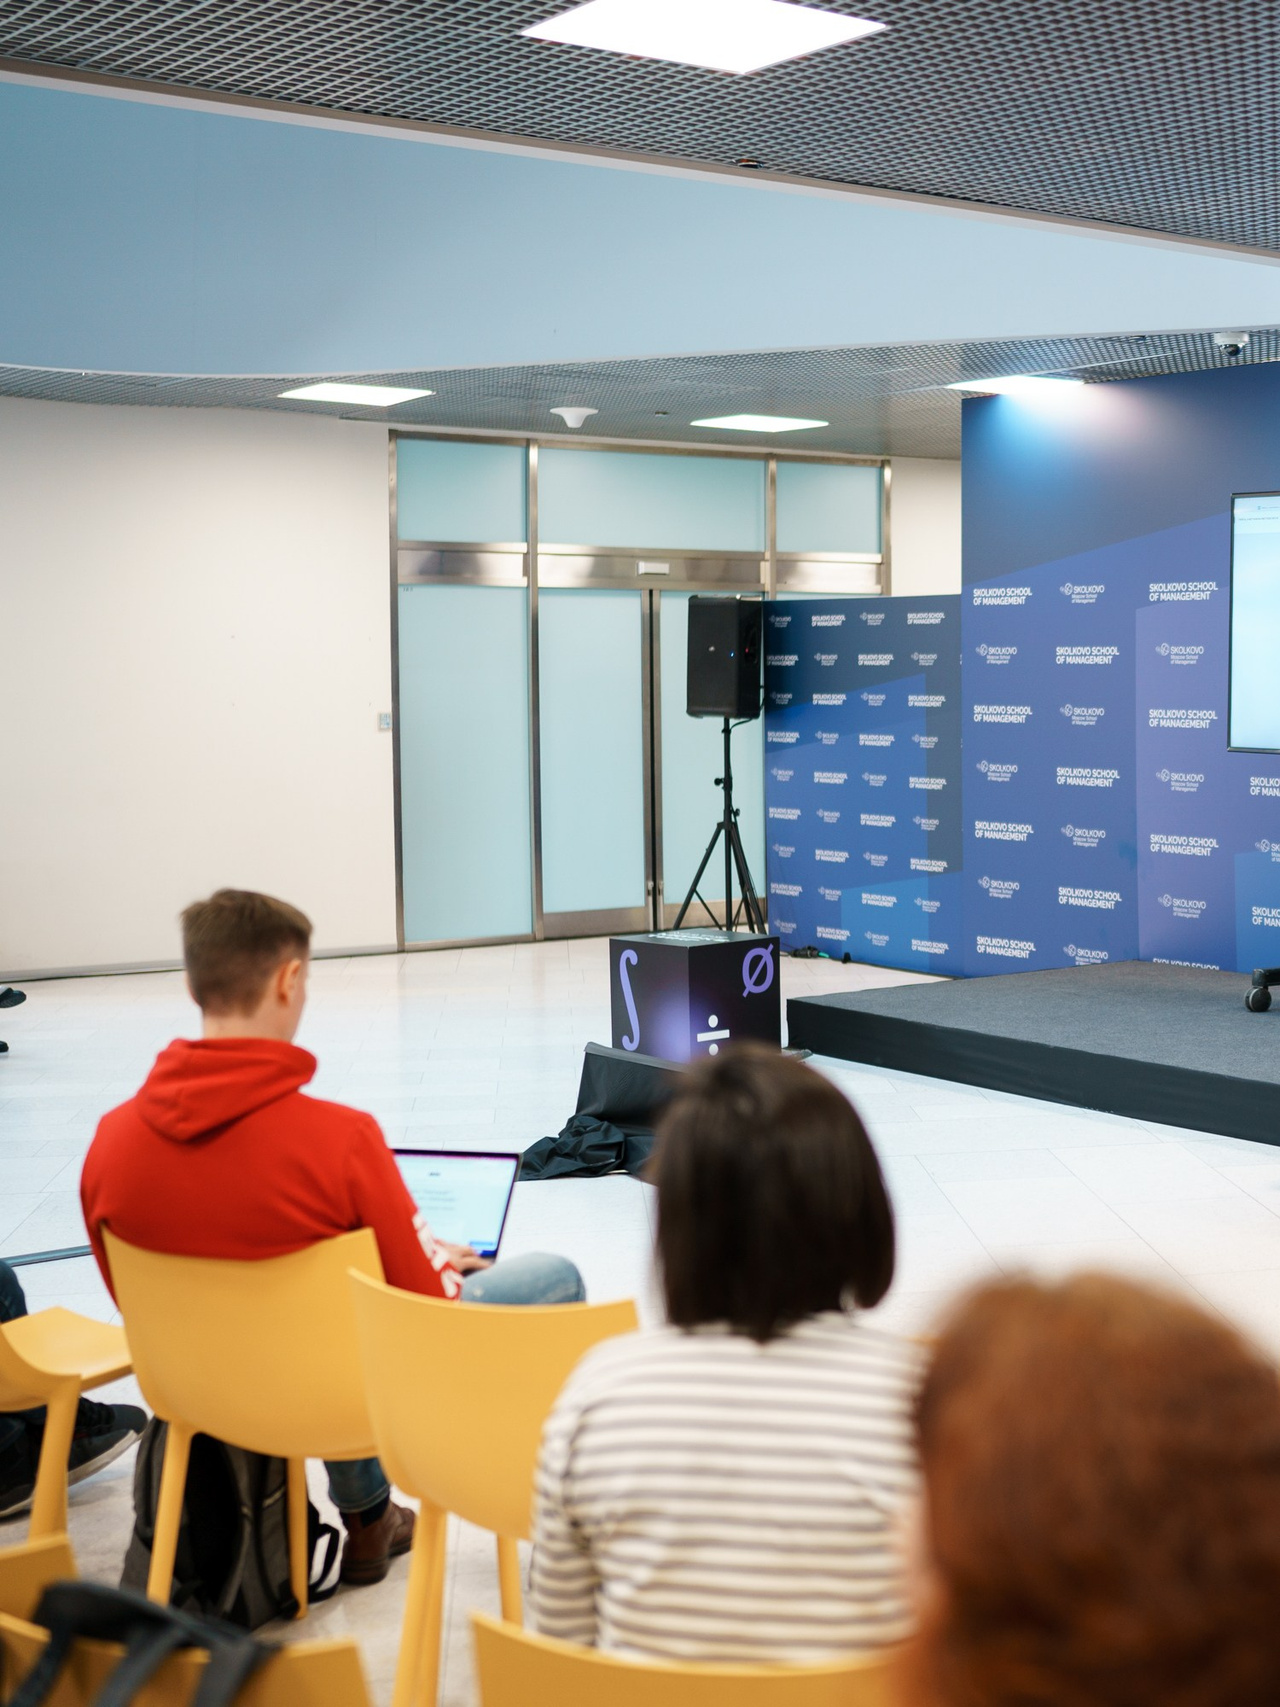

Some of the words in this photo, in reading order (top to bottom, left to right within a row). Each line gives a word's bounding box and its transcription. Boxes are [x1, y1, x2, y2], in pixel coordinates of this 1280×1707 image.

[974, 588, 1005, 596] SKOLKOVO
[1007, 587, 1032, 596] SCHOOL
[1149, 583, 1186, 592] SKOLKOVO
[1188, 582, 1218, 591] SCHOOL
[974, 597, 981, 605] OF
[983, 597, 1025, 605] MANAGEMENT
[1149, 592, 1159, 601] OF
[1160, 591, 1210, 601] MANAGEMENT
[1056, 647, 1090, 655] SKOLKOVO
[1092, 647, 1119, 655] SCHOOL
[1056, 656, 1065, 664] OF
[1066, 656, 1112, 664] MANAGEMENT
[974, 706, 1005, 714] SKOLKOVO
[1007, 706, 1032, 715] SCHOOL
[1149, 709, 1186, 719] SKOLKOVO
[1188, 710, 1217, 719] SCHOOL
[974, 714, 982, 722] OF
[983, 714, 1025, 723] MANAGEMENT
[1149, 719, 1158, 727] OF
[1160, 719, 1209, 728] MANAGEMENT
[1057, 767, 1090, 777] SKOLKOVO
[1092, 769, 1119, 778] SCHOOL
[1057, 776, 1065, 785] OF
[1067, 777, 1112, 787] MANAGEMENT
[1250, 787, 1260, 796] OF
[975, 821, 1006, 831] SKOLKOVO
[1008, 823, 1033, 833] SCHOOL
[975, 830, 983, 838] OF
[984, 830, 1027, 841] MANAGEMENT
[1151, 835, 1187, 846] SKOLKOVO
[1189, 837, 1218, 848] SCHOOL
[1151, 844, 1160, 853] OF
[1161, 844, 1210, 856] MANAGEMENT
[1059, 887, 1092, 898] SKOLKOVO
[1095, 890, 1121, 901] SCHOOL
[1059, 896, 1067, 905] OF
[1069, 897, 1114, 909] MANAGEMENT
[1252, 917, 1262, 926] OF
[977, 936, 1008, 948] SKOLKOVO
[1010, 940, 1036, 951] SCHOOL
[977, 945, 985, 954] OF
[986, 946, 1029, 958] MANAGEMENT
